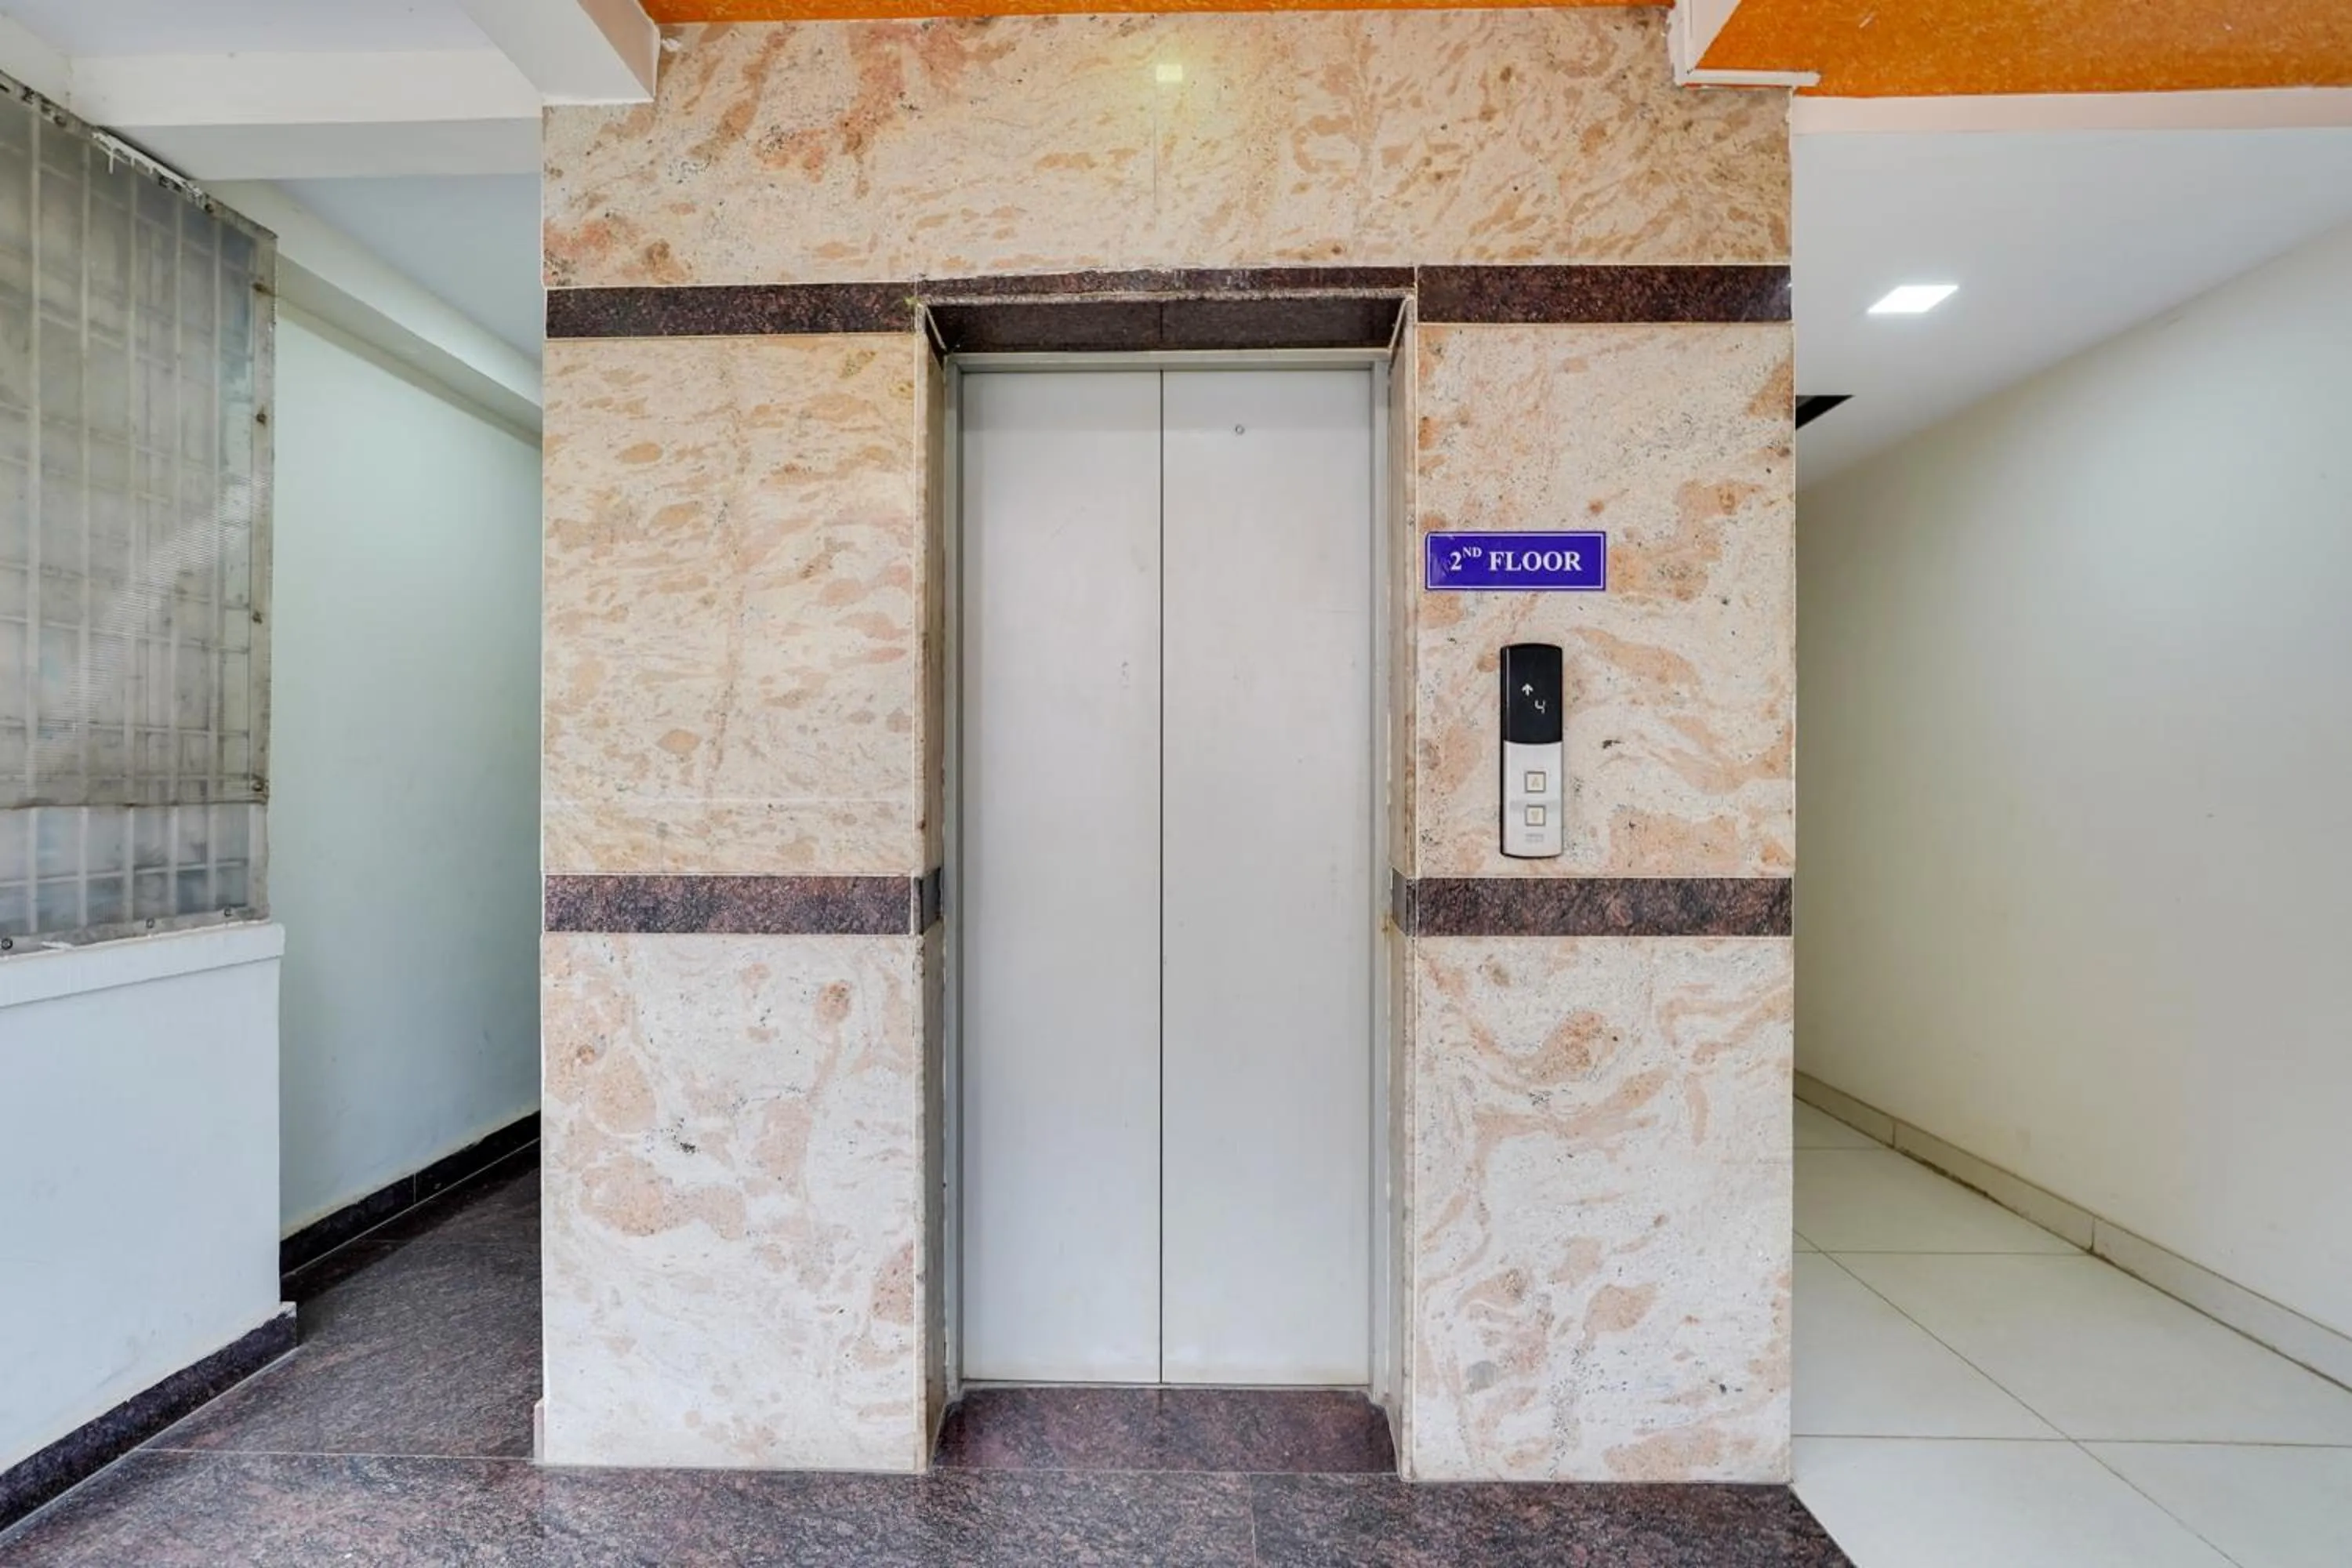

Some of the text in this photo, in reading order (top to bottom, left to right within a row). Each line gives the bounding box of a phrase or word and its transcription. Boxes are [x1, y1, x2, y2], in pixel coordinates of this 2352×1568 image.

[1450, 546, 1582, 572] 2ND FLOOR
[1534, 699, 1546, 714] 4
